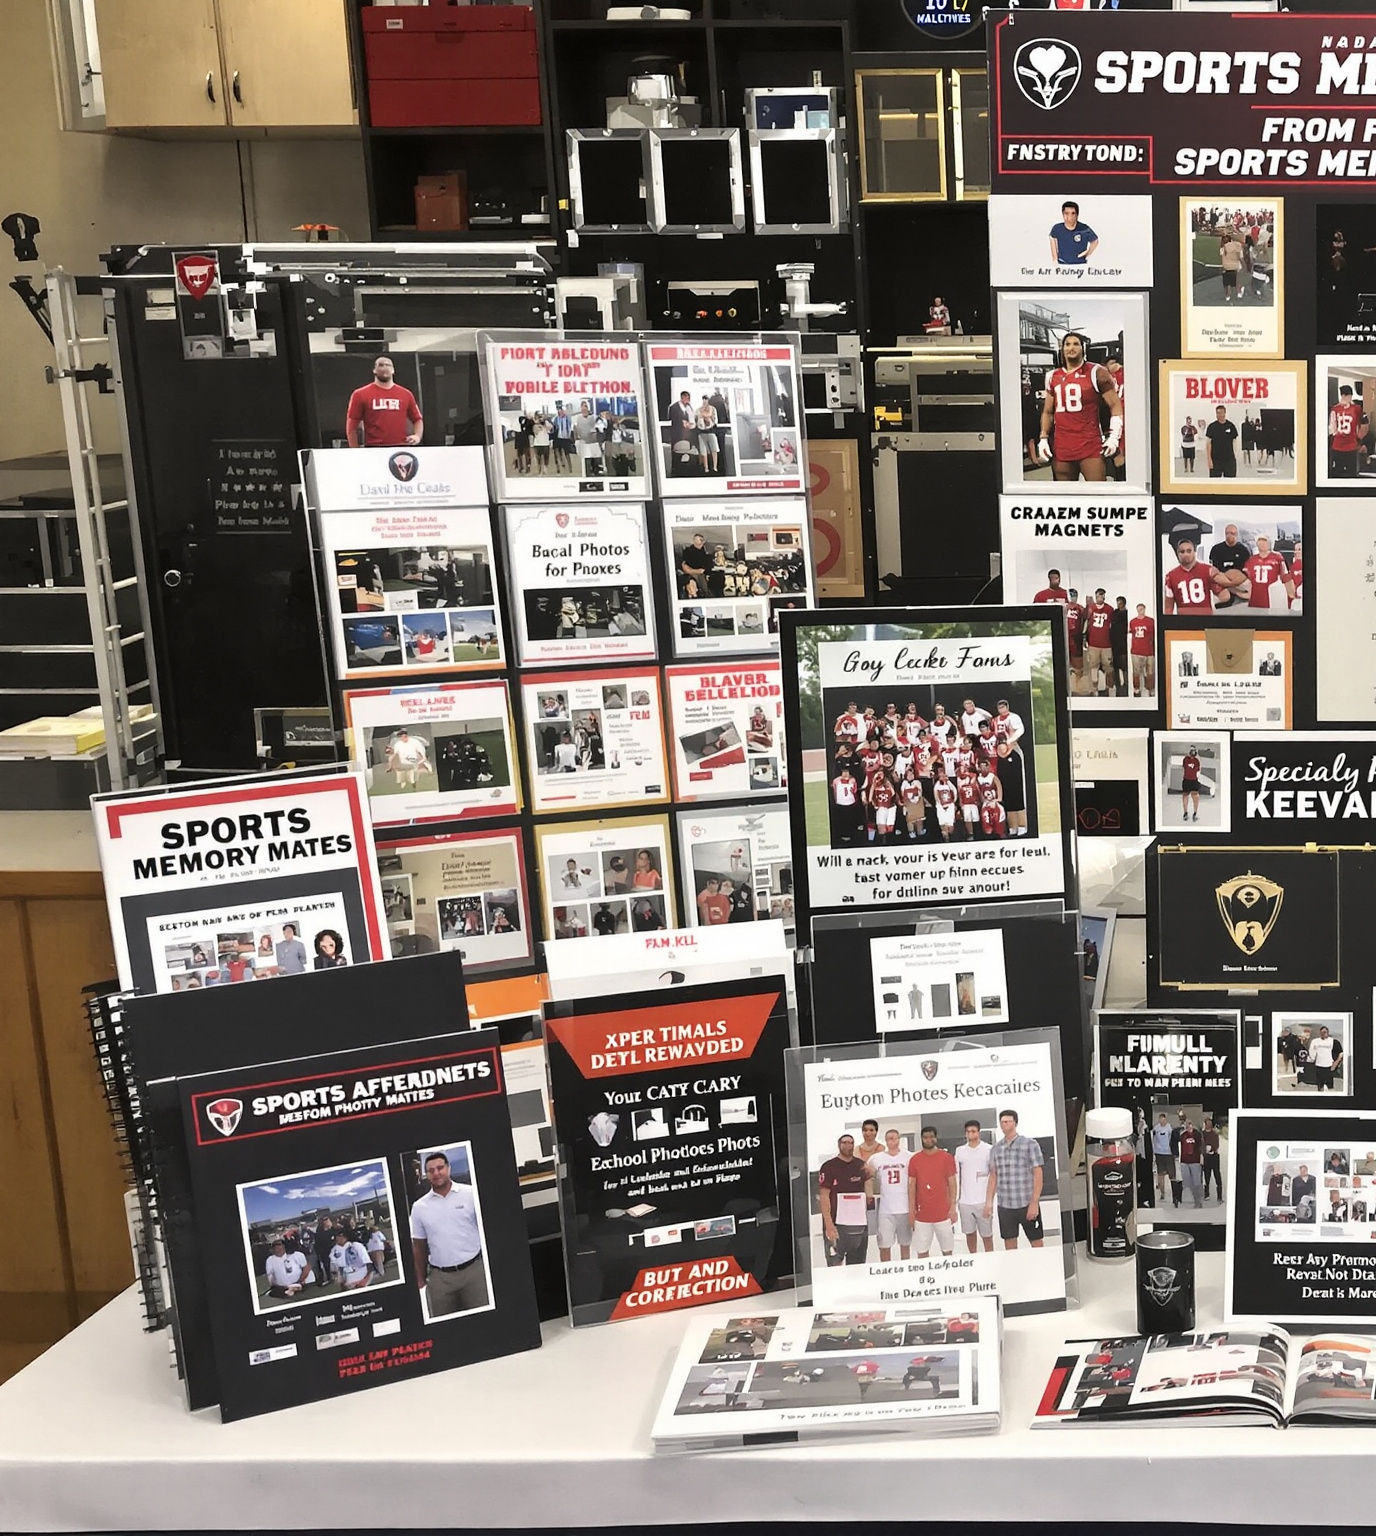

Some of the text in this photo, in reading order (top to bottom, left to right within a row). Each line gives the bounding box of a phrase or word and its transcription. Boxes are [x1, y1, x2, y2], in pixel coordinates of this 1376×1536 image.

[1095, 51, 1301, 93] SPORTS
[1262, 118, 1355, 142] FROM
[1008, 144, 1143, 161] FNSTRY TOND:
[1175, 148, 1308, 176] SPORTS
[1054, 383, 1084, 415] 18
[1186, 378, 1268, 399] BLOVER
[1087, 507, 1147, 519] SUMPE
[1035, 524, 1123, 537] MAGNETS
[581, 543, 629, 556] Photos
[546, 563, 567, 576] for
[1178, 579, 1205, 604] 18
[160, 808, 311, 850] SPORTS
[133, 834, 353, 881] MEMORY MATES
[817, 855, 841, 867] Will
[1000, 847, 1017, 858] for
[873, 888, 892, 899] for
[252, 1085, 346, 1118] SPORTS
[643, 1259, 730, 1288] BUT AND
